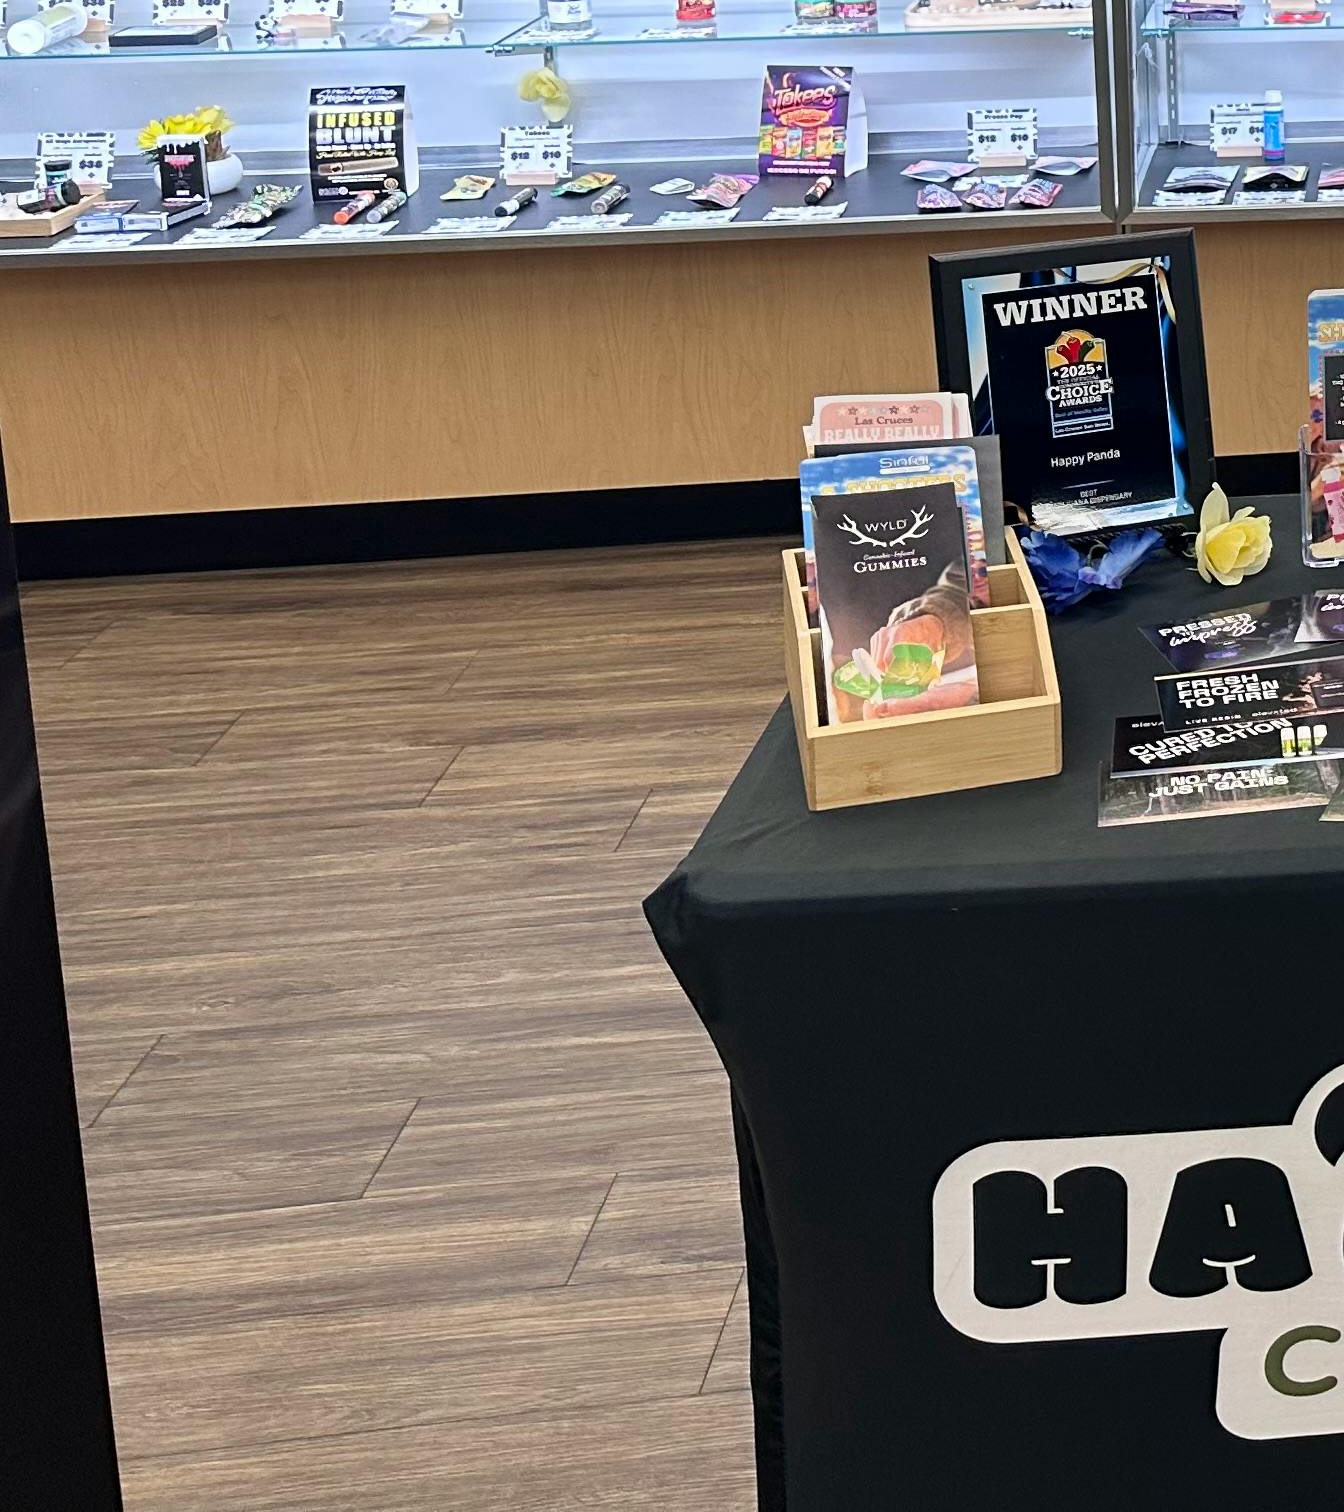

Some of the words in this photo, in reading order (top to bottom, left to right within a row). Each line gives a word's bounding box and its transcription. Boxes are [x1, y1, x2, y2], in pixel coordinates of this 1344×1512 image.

[316, 112, 395, 128] INFUSED
[316, 126, 395, 143] BLUNT
[993, 286, 1148, 327] WINNER
[1060, 363, 1096, 379] 2025
[1046, 377, 1114, 401] CHOICE
[1058, 395, 1103, 408] AWARDS
[854, 417, 873, 426] Las
[876, 416, 913, 425] Cruces
[879, 455, 929, 468] Sinful
[1050, 454, 1085, 469] Happy
[1087, 448, 1121, 462] Panda
[865, 519, 908, 533] WYLD
[853, 556, 927, 573] GUMMIES
[1176, 673, 1259, 692] FRESH
[1178, 680, 1280, 700] FROZEN
[1178, 696, 1215, 709] TO
[1222, 689, 1279, 705] FIRE
